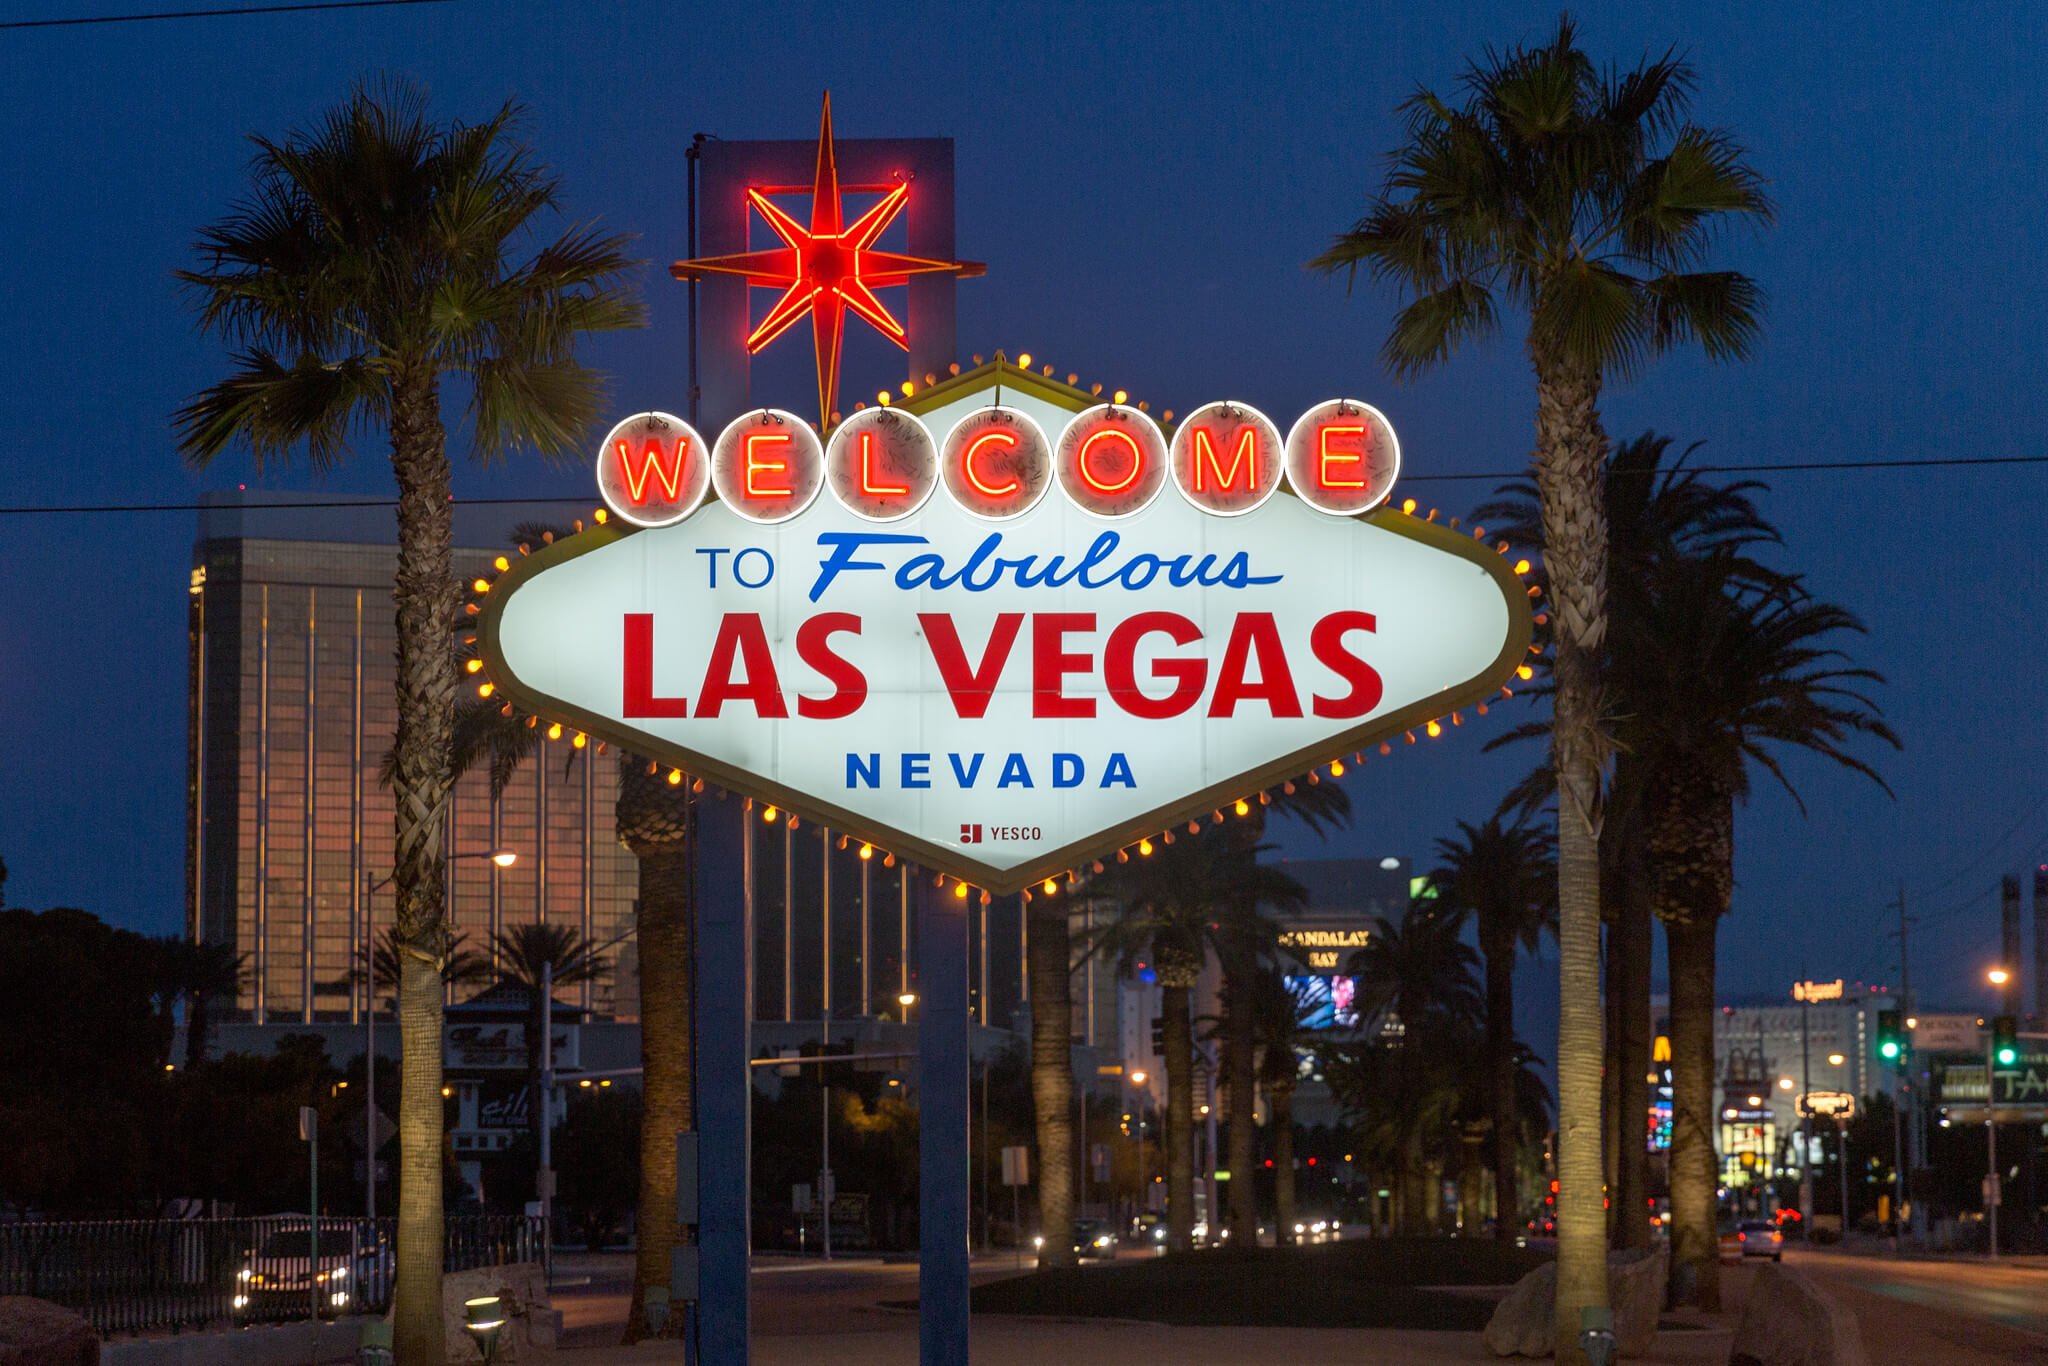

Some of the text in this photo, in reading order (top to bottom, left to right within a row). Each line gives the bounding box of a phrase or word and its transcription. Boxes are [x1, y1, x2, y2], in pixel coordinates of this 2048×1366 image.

[614, 421, 1368, 505] WELCOME
[695, 530, 1284, 604] TO Fabulous
[624, 611, 1382, 719] LAS VEGAS
[845, 752, 1137, 789] NEVADA
[990, 826, 1042, 841] YESCO
